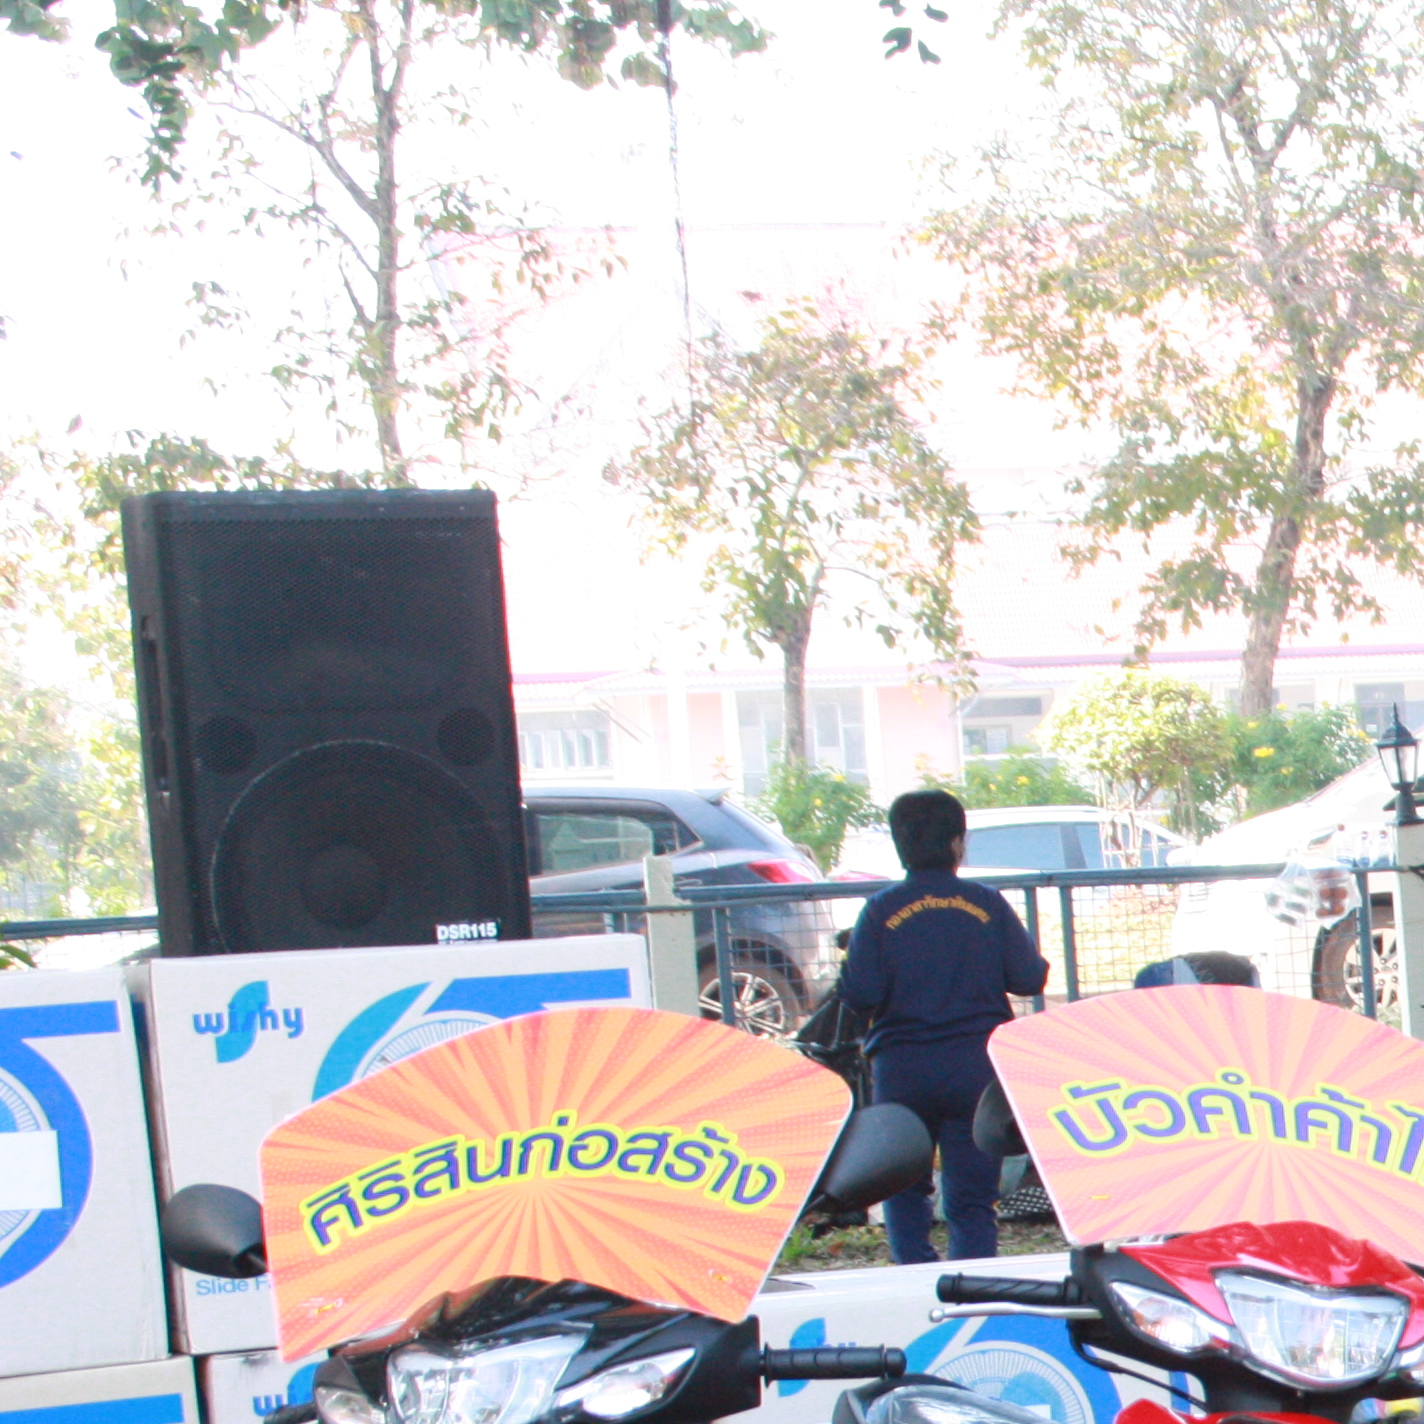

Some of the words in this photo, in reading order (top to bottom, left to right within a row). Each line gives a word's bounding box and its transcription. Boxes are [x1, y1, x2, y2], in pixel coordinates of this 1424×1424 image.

[436, 922, 497, 941] DSR115
[307, 1113, 778, 1248] ศิริสินก่อสร้าง
[196, 1277, 249, 1296] Slide
